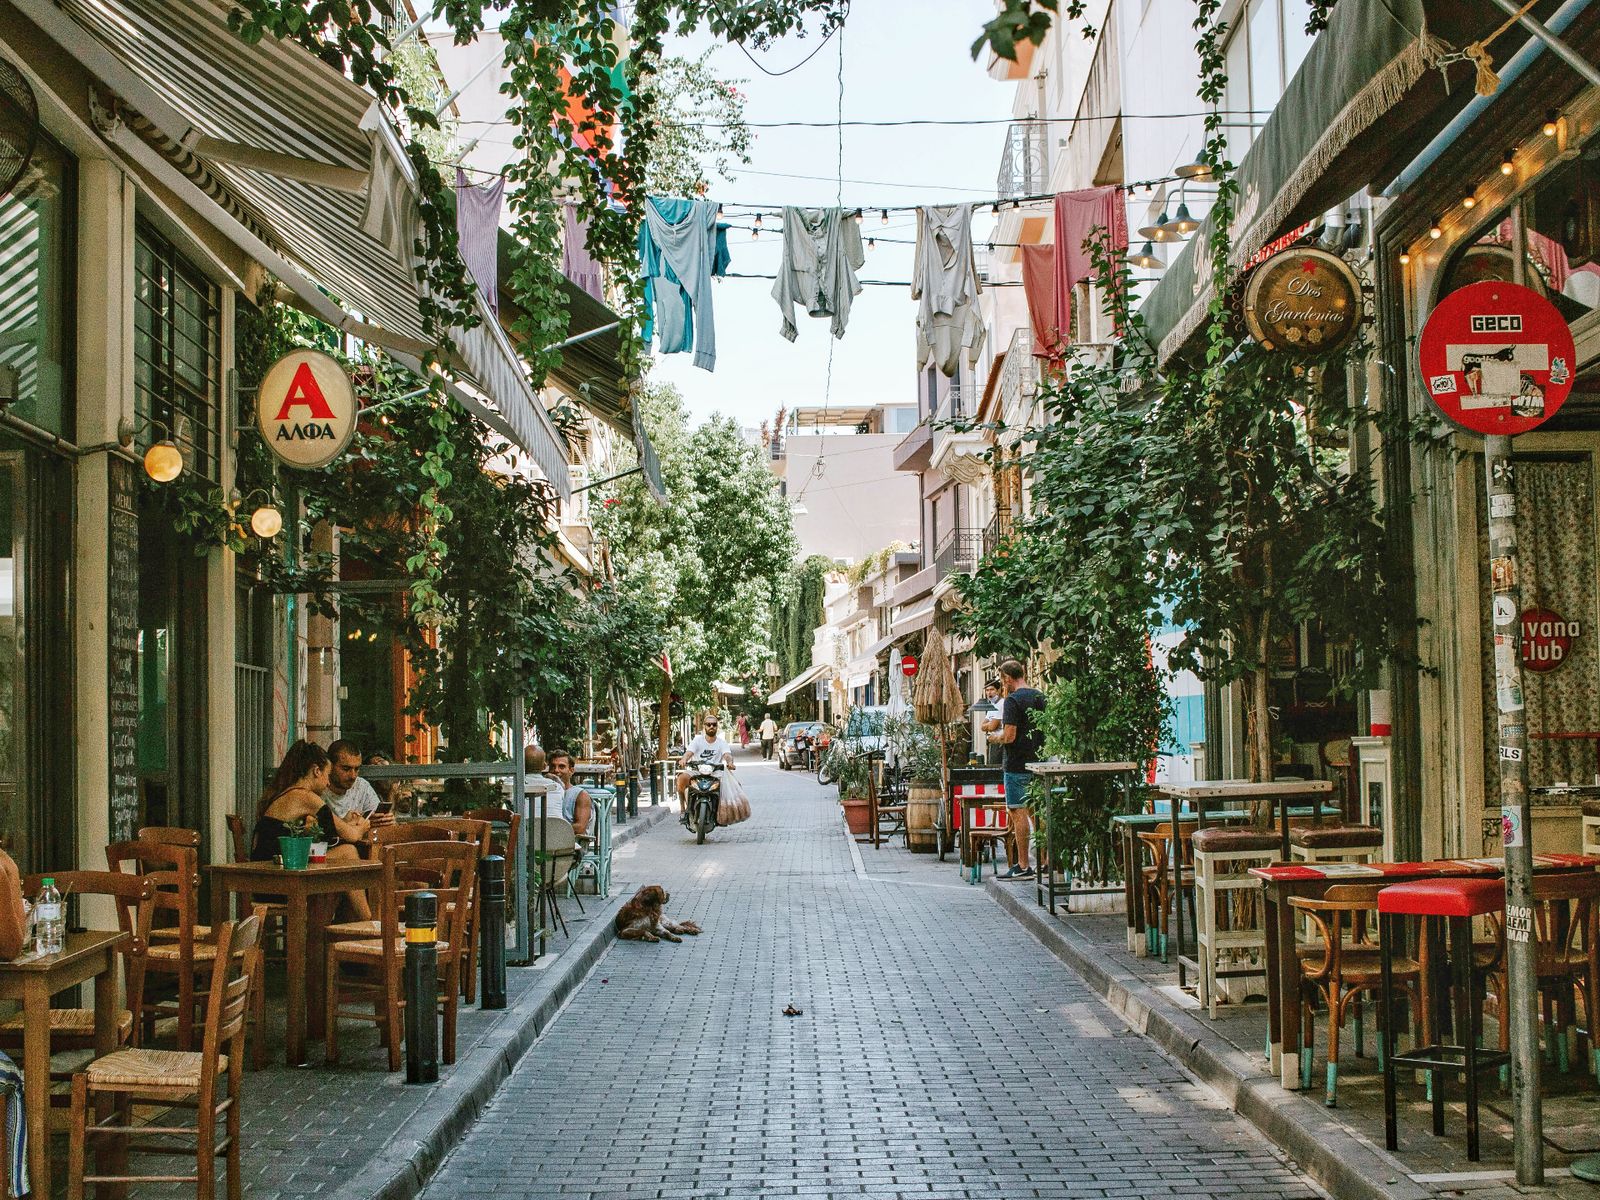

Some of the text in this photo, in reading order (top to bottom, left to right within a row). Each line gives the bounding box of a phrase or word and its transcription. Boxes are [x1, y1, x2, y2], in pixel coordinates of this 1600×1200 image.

[1286, 276, 1322, 298] Dos
[1264, 298, 1346, 324] Gardenias
[275, 422, 336, 441] ΑΛΦΑ
[1521, 621, 1580, 638] vana
